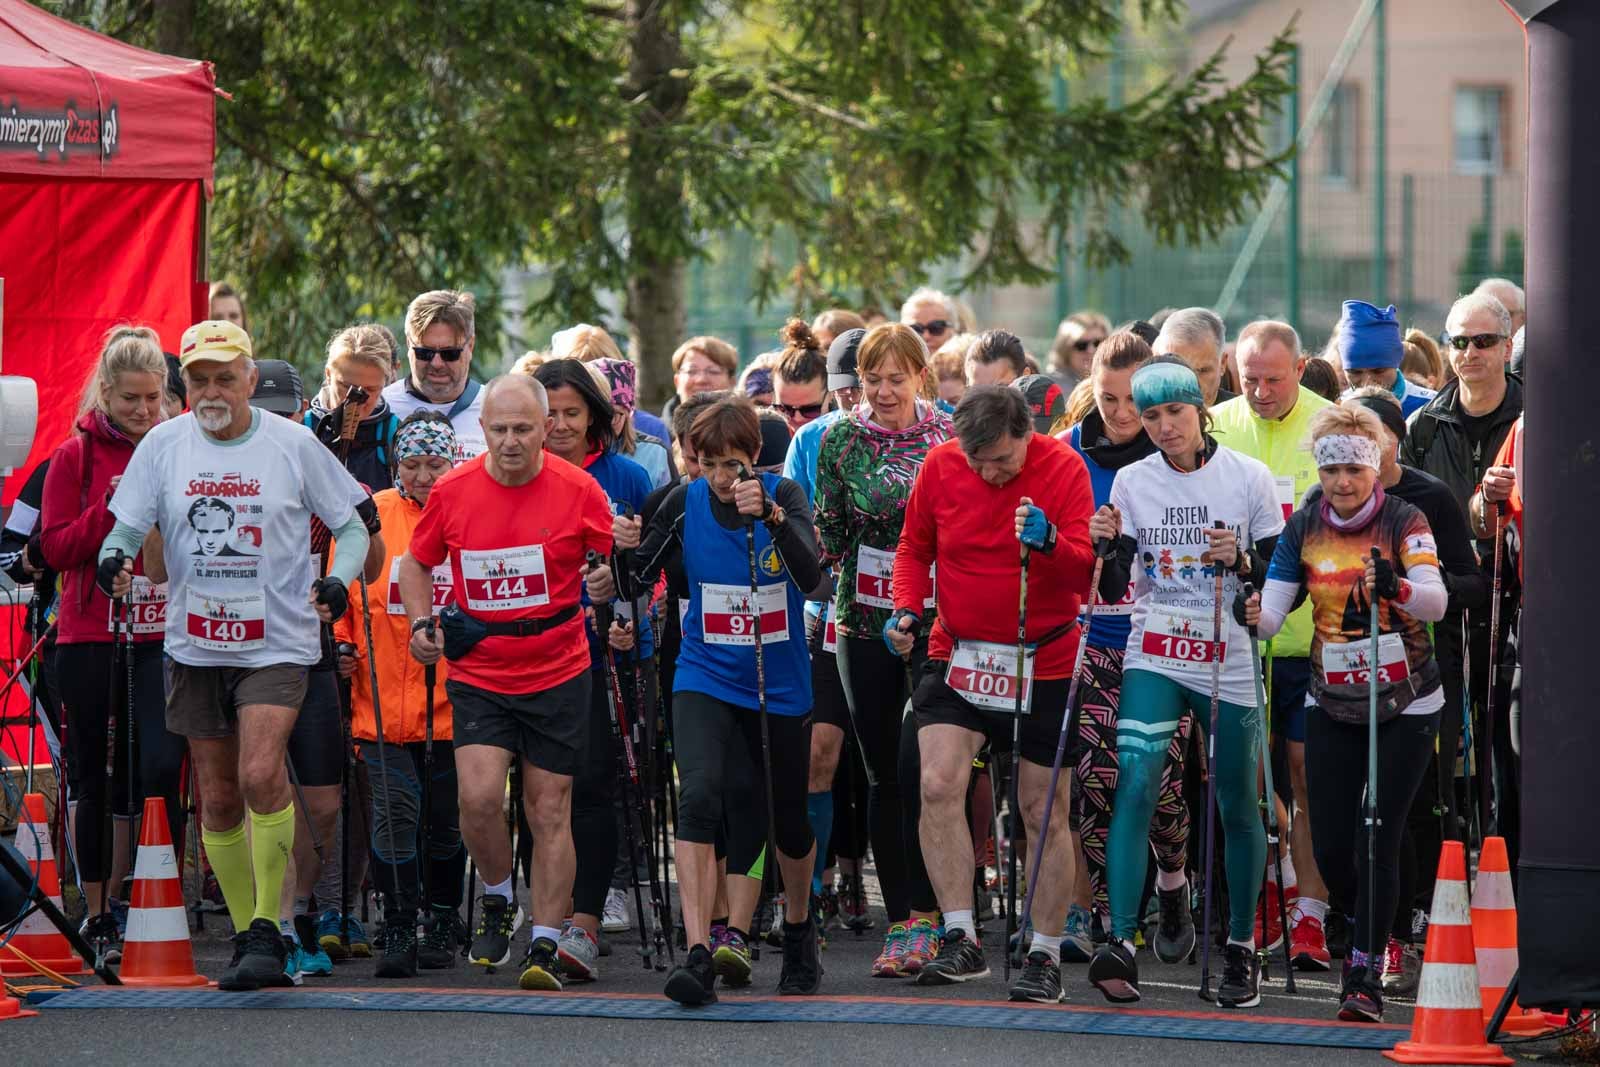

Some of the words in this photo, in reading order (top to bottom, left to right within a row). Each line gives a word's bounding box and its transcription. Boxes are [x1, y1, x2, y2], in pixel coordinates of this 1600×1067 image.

[1161, 505, 1209, 526] JESTEM
[481, 577, 529, 600] 144
[202, 620, 247, 641] 140
[729, 615, 755, 635] 97
[1161, 637, 1208, 661] 103
[966, 671, 1010, 697] 100
